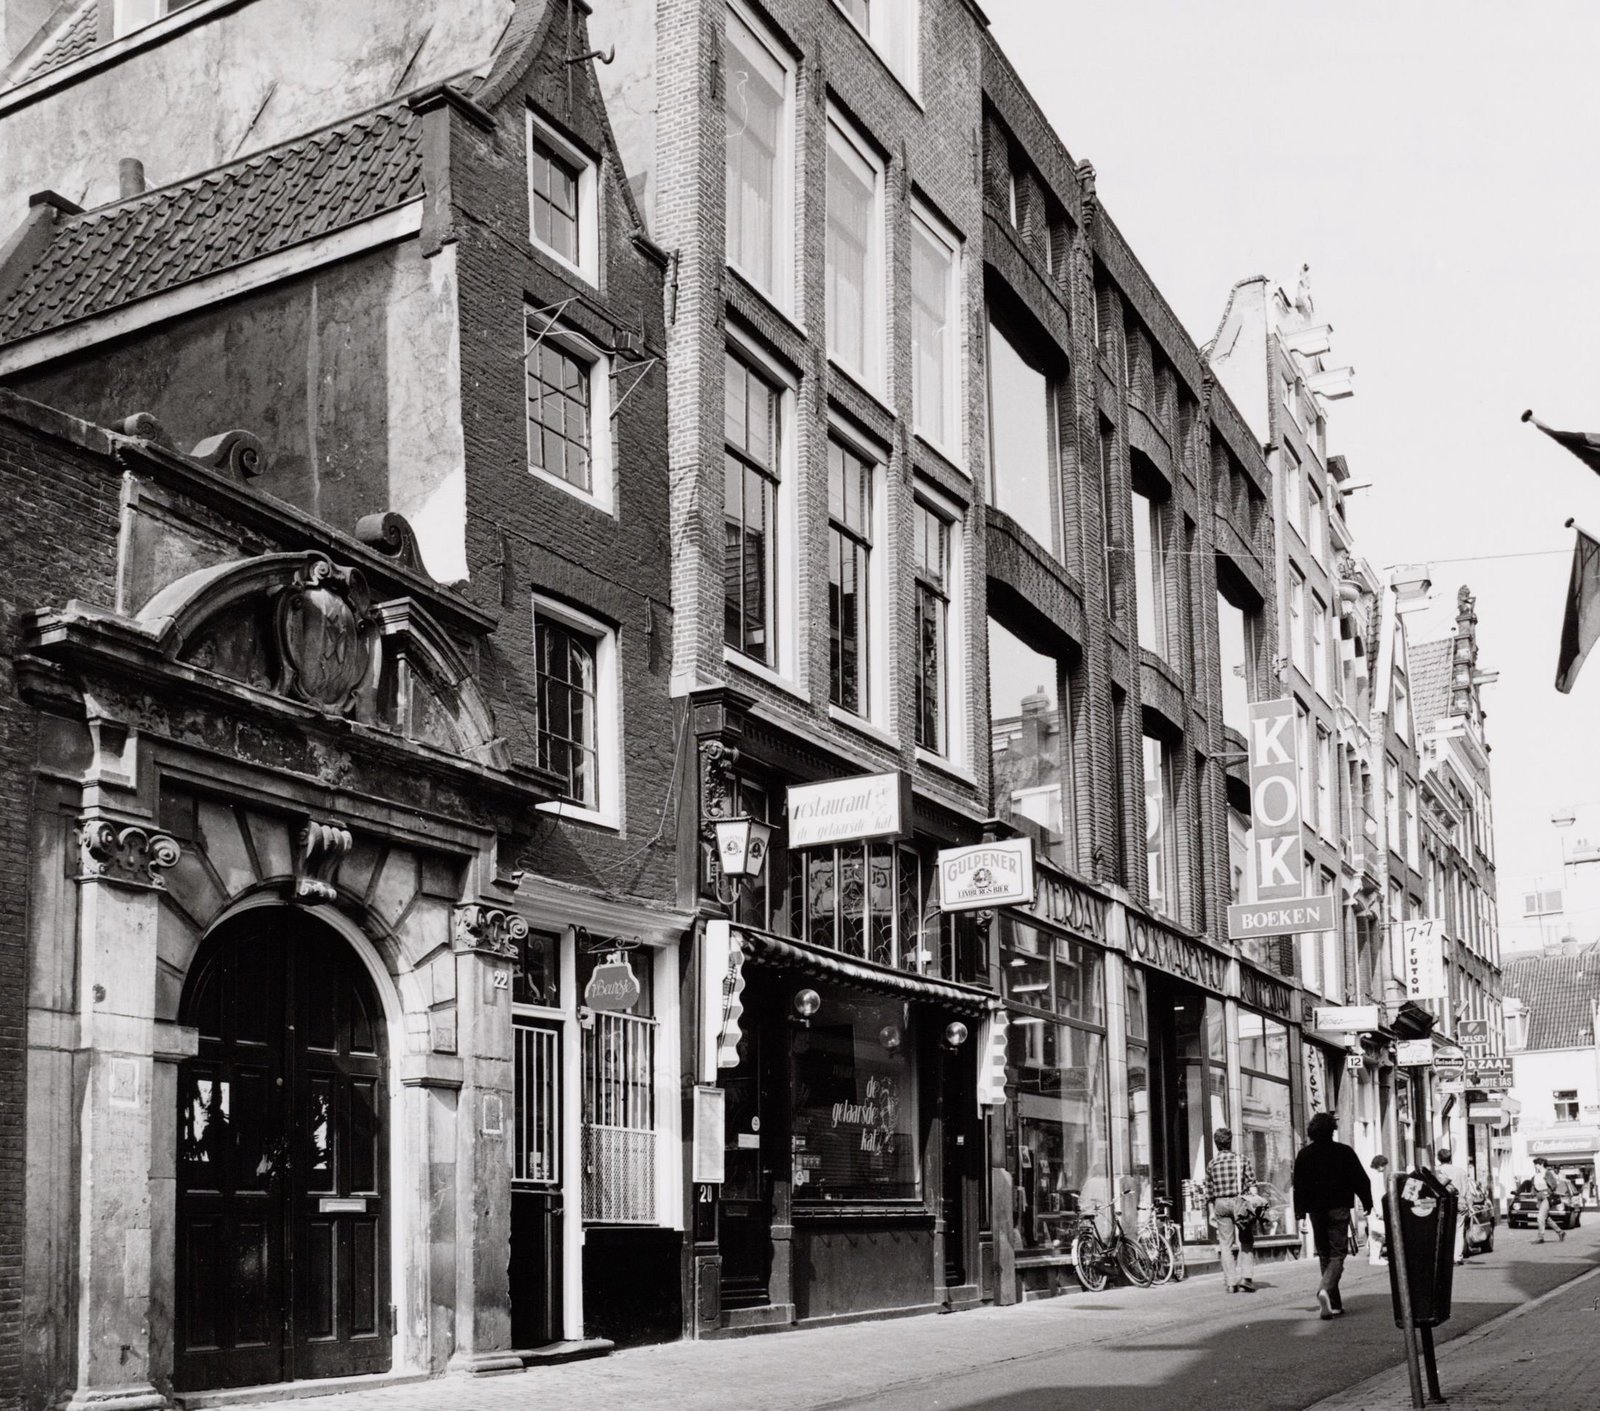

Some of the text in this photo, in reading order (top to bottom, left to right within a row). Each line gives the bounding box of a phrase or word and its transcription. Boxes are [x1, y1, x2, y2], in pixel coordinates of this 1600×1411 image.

[793, 789, 872, 820] restaurant
[1252, 715, 1300, 888] KOK
[948, 853, 1017, 882] GULPENER
[1241, 907, 1321, 930] BOEKEN
[1406, 921, 1433, 942] 7+7
[494, 971, 508, 989] 22
[1410, 948, 1419, 994] FUTON
[1460, 1034, 1487, 1043] DELSEY
[1350, 1057, 1361, 1067] 12
[866, 1076, 880, 1098] de
[831, 1099, 880, 1129] gelaarsde
[861, 1128, 877, 1151] kat
[700, 1185, 713, 1202] 20
